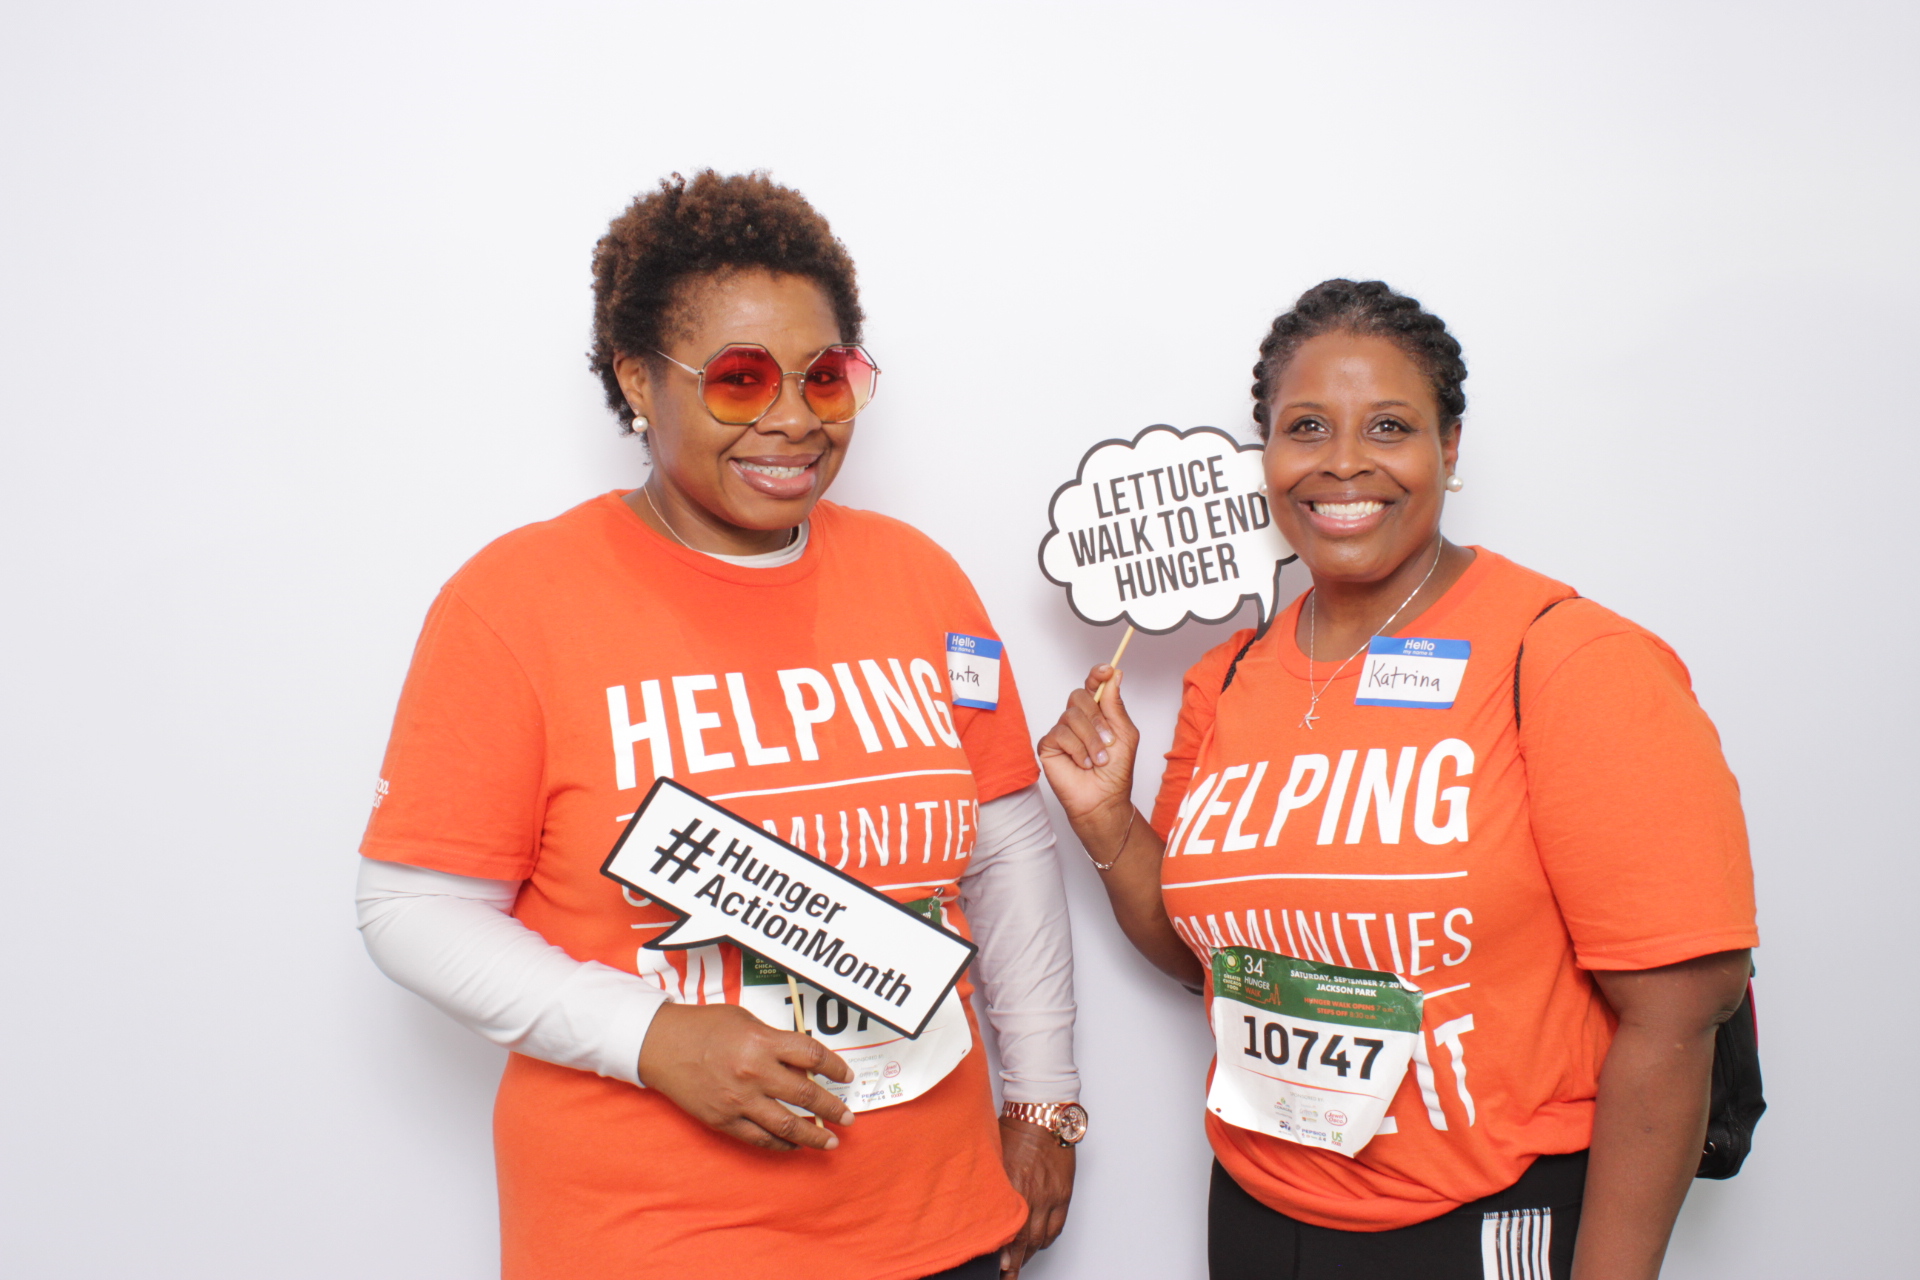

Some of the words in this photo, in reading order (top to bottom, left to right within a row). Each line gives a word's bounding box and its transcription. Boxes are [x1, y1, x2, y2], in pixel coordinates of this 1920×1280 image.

[1093, 455, 1229, 519] LETTUCE
[1068, 515, 1154, 567] WALK
[1157, 506, 1199, 548] TO
[1204, 491, 1270, 540] END
[1114, 543, 1240, 601] HUNGER
[951, 634, 976, 649] Hello
[1404, 639, 1435, 651] Hello
[1368, 660, 1441, 691] Katrina
[606, 658, 961, 790] HELPING
[1163, 738, 1475, 858] HELPING
[694, 873, 912, 1008] ActionMonth
[1244, 976, 1270, 990] HUNGER
[1290, 970, 1332, 982] SATURDAY,
[1333, 976, 1378, 987] SEPTEMBER
[1379, 981, 1386, 989] 7,
[1245, 986, 1262, 997] WALK
[1316, 983, 1353, 995] JACKSON
[1354, 987, 1377, 998] PARK
[1304, 997, 1331, 1006] HUNGER
[1332, 1000, 1351, 1009] WALK
[1352, 1003, 1375, 1011] OPENS
[1317, 1007, 1335, 1015] STEPS
[1335, 1009, 1348, 1017] OFF
[1349, 1010, 1364, 1019] 8:30
[1243, 1015, 1384, 1080] 10747
[1301, 1128, 1327, 1137] PEPSICO
